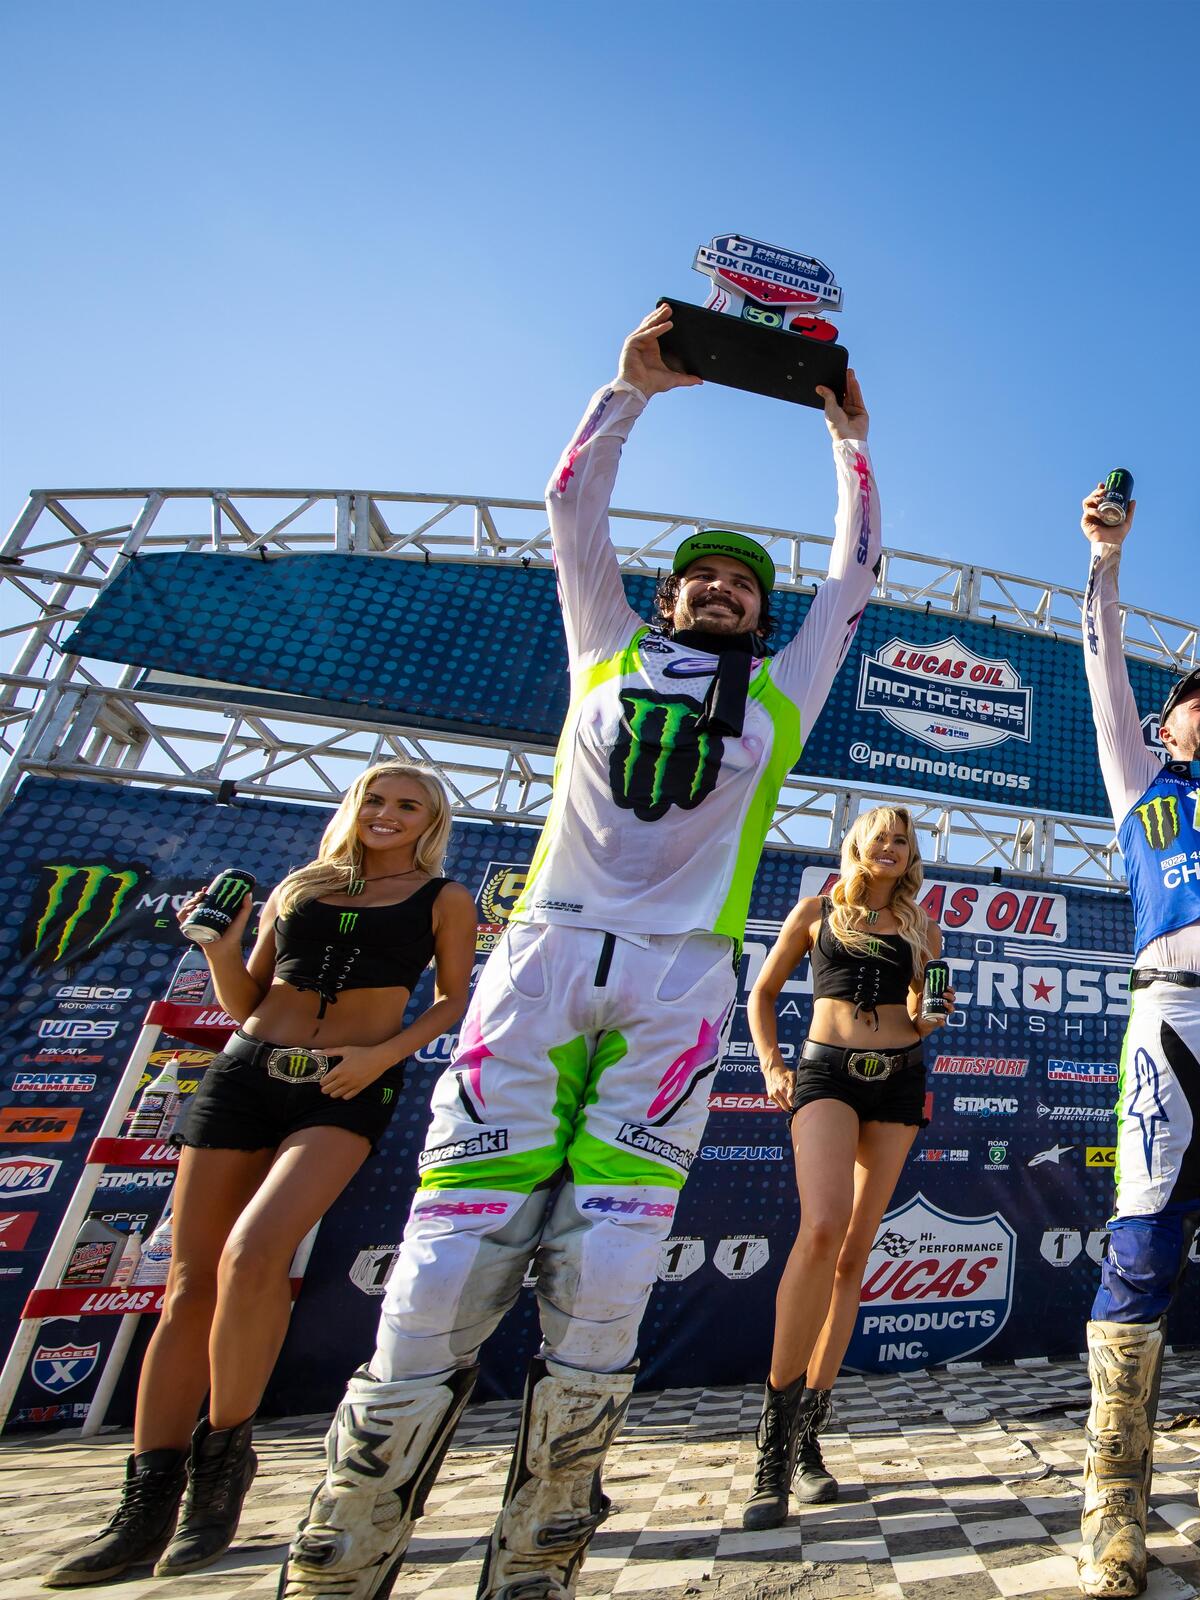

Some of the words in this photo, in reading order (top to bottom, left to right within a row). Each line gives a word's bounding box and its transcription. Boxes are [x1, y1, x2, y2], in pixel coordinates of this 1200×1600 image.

[754, 254, 818, 277] AUCTION.COM
[755, 248, 820, 272] PRISTINE
[706, 251, 740, 269] FOX
[742, 262, 820, 293] RACEWAY
[823, 286, 832, 297] II
[729, 272, 808, 299] NATIONAL
[748, 308, 781, 327] 50
[691, 542, 765, 564] Kawasaki
[892, 650, 967, 679] LUCAS
[970, 665, 1004, 686] OIL
[929, 683, 969, 696] PRO
[868, 676, 1024, 720] MOTOCROSS
[867, 691, 1023, 726] CHAMPIONSHIP
[849, 742, 1031, 790] @promotocross
[1162, 855, 1186, 867] 2022
[986, 891, 1058, 936] OIL
[56, 986, 132, 999] GEICO
[59, 1002, 116, 1010] MOTORCYCLE
[194, 1011, 240, 1026] LUCA
[39, 1020, 119, 1039] WPS
[1049, 1060, 1118, 1074] PARTS
[15, 1074, 96, 1084] PARTS
[1049, 1072, 1118, 1083] UNLIMITED
[13, 1083, 94, 1091] UNLIMITED
[708, 1097, 779, 1109] ASGAS
[954, 1097, 1018, 1112] STACYC
[1051, 1106, 1114, 1117] DUNLOP
[5, 1117, 67, 1132] KTM
[420, 1131, 505, 1165] awasaki
[701, 1146, 784, 1160] SUZUKI
[993, 1152, 1001, 1161] 2
[98, 1172, 174, 1187] STACYC
[101, 1213, 149, 1221] oPro
[920, 1233, 936, 1241] HI-
[919, 1243, 1003, 1253] PERFORMANCE
[860, 1257, 998, 1302] UCAS
[80, 1292, 153, 1311] LUCAS
[862, 1310, 995, 1335] PRODUCTS
[40, 1350, 95, 1359] RACER
[45, 1361, 80, 1384] X
